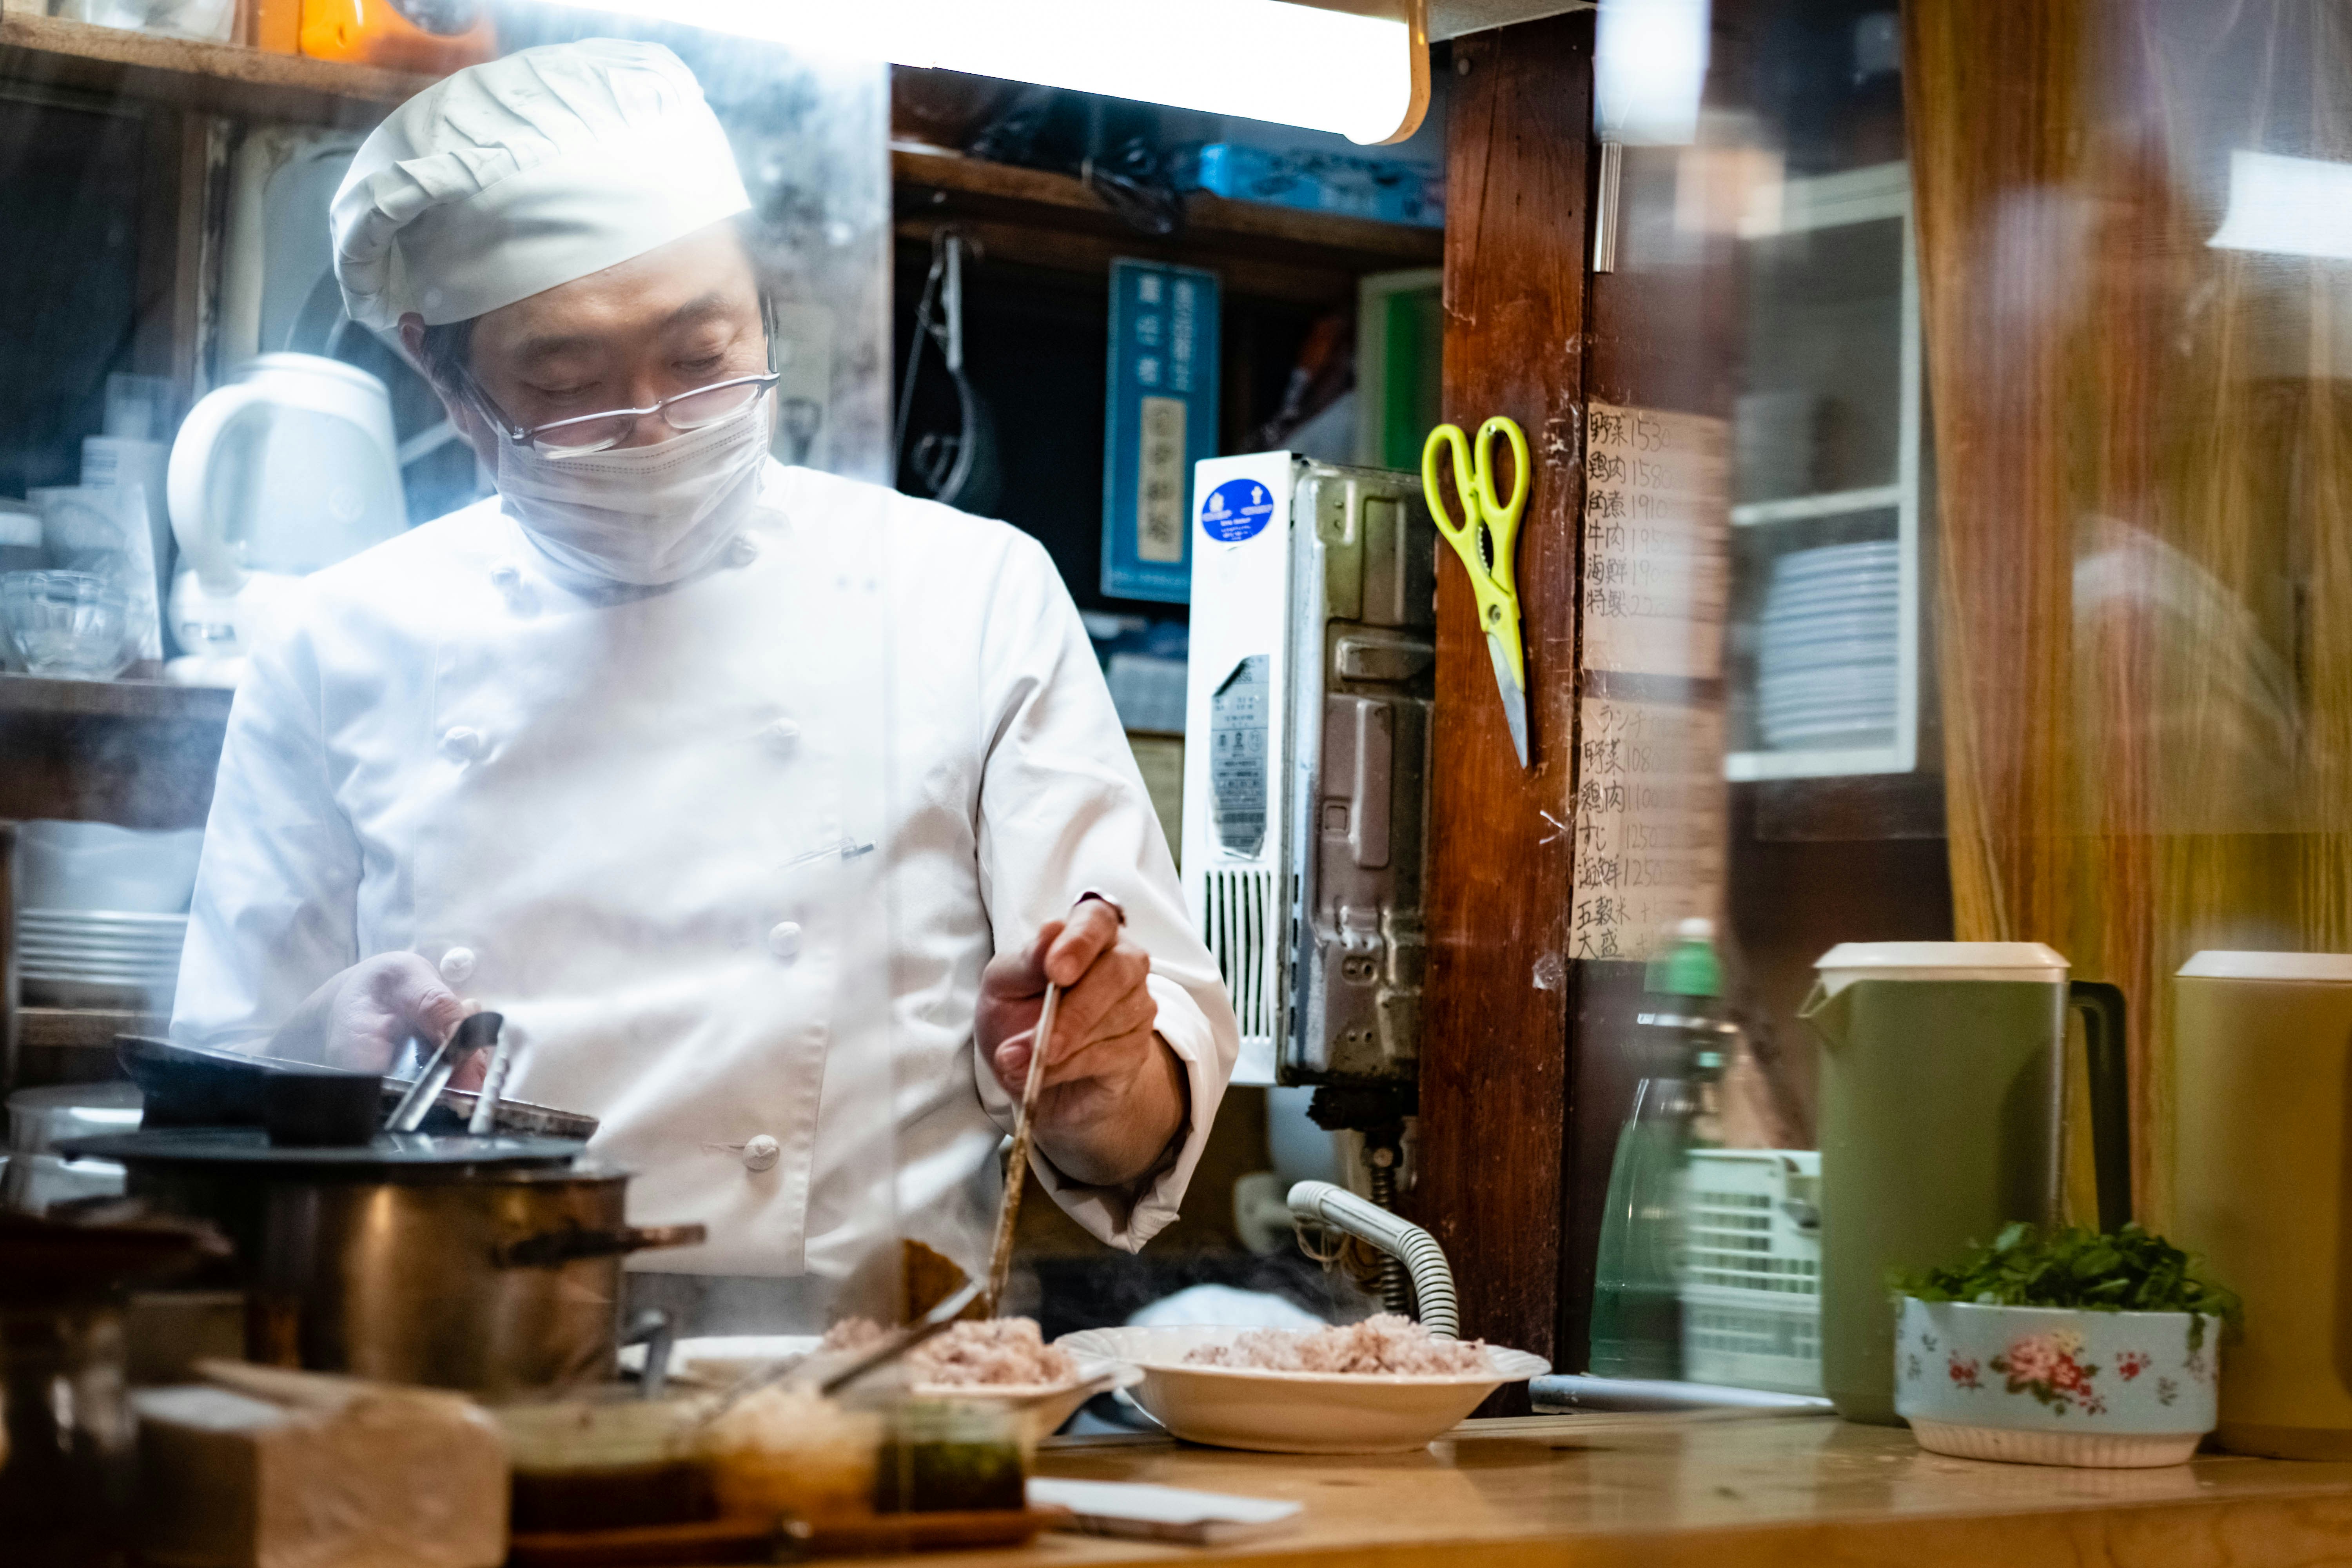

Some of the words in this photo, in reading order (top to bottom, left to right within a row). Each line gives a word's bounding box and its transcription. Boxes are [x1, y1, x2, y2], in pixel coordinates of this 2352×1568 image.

[1590, 411, 1627, 447] 野菜
[1632, 419, 1671, 452] 1530
[1589, 451, 1626, 484] 鶏肉
[1633, 458, 1672, 489] 1580
[1588, 490, 1626, 518] 角煮
[1632, 494, 1668, 519] 1910
[1588, 519, 1624, 552] 牛肉
[1632, 527, 1672, 554] 1950
[1587, 553, 1627, 585] 海鮮
[1632, 559, 1670, 586] 1900
[1587, 588, 1627, 618] 特製
[1600, 705, 1646, 738] ランチ
[1584, 738, 1625, 776] 野菜
[1627, 746, 1661, 773] 1080
[1582, 779, 1625, 813] 鶏肉
[1628, 784, 1659, 811] 1100
[1579, 814, 1606, 856] すじ
[1626, 822, 1657, 850] 1250
[1578, 854, 1622, 890] 海鮮
[1624, 858, 1662, 887] 1250
[1577, 895, 1631, 931] 五穀米
[1578, 929, 1624, 960] 大盛
